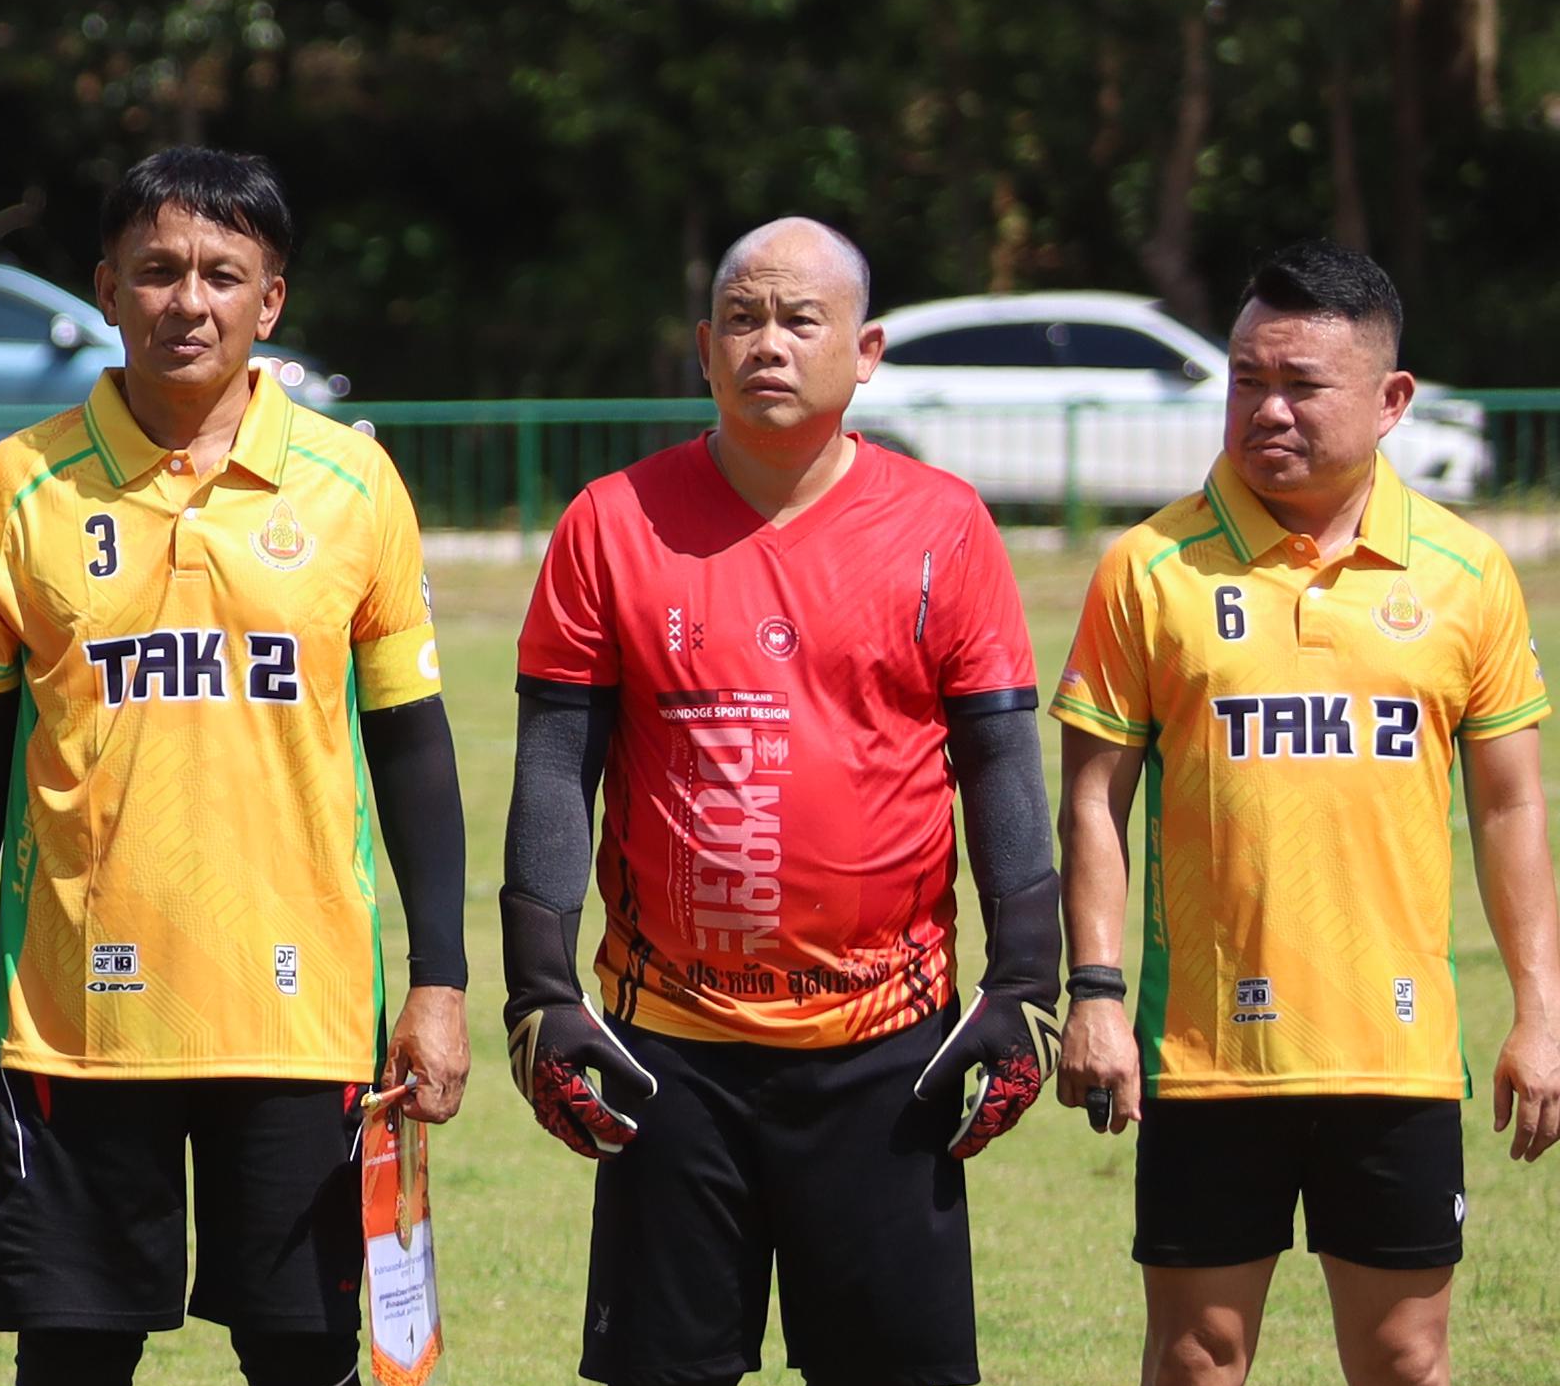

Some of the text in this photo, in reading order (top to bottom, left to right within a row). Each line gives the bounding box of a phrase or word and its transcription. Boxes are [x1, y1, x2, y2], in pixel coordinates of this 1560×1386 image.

[83, 514, 120, 577] 3
[1215, 585, 1246, 641] 6
[83, 628, 301, 706] TAK 2
[714, 706, 749, 719] SPORT
[750, 706, 791, 720] DESIGN
[732, 691, 773, 703] THAILAND
[1210, 693, 1421, 761] TAK 2
